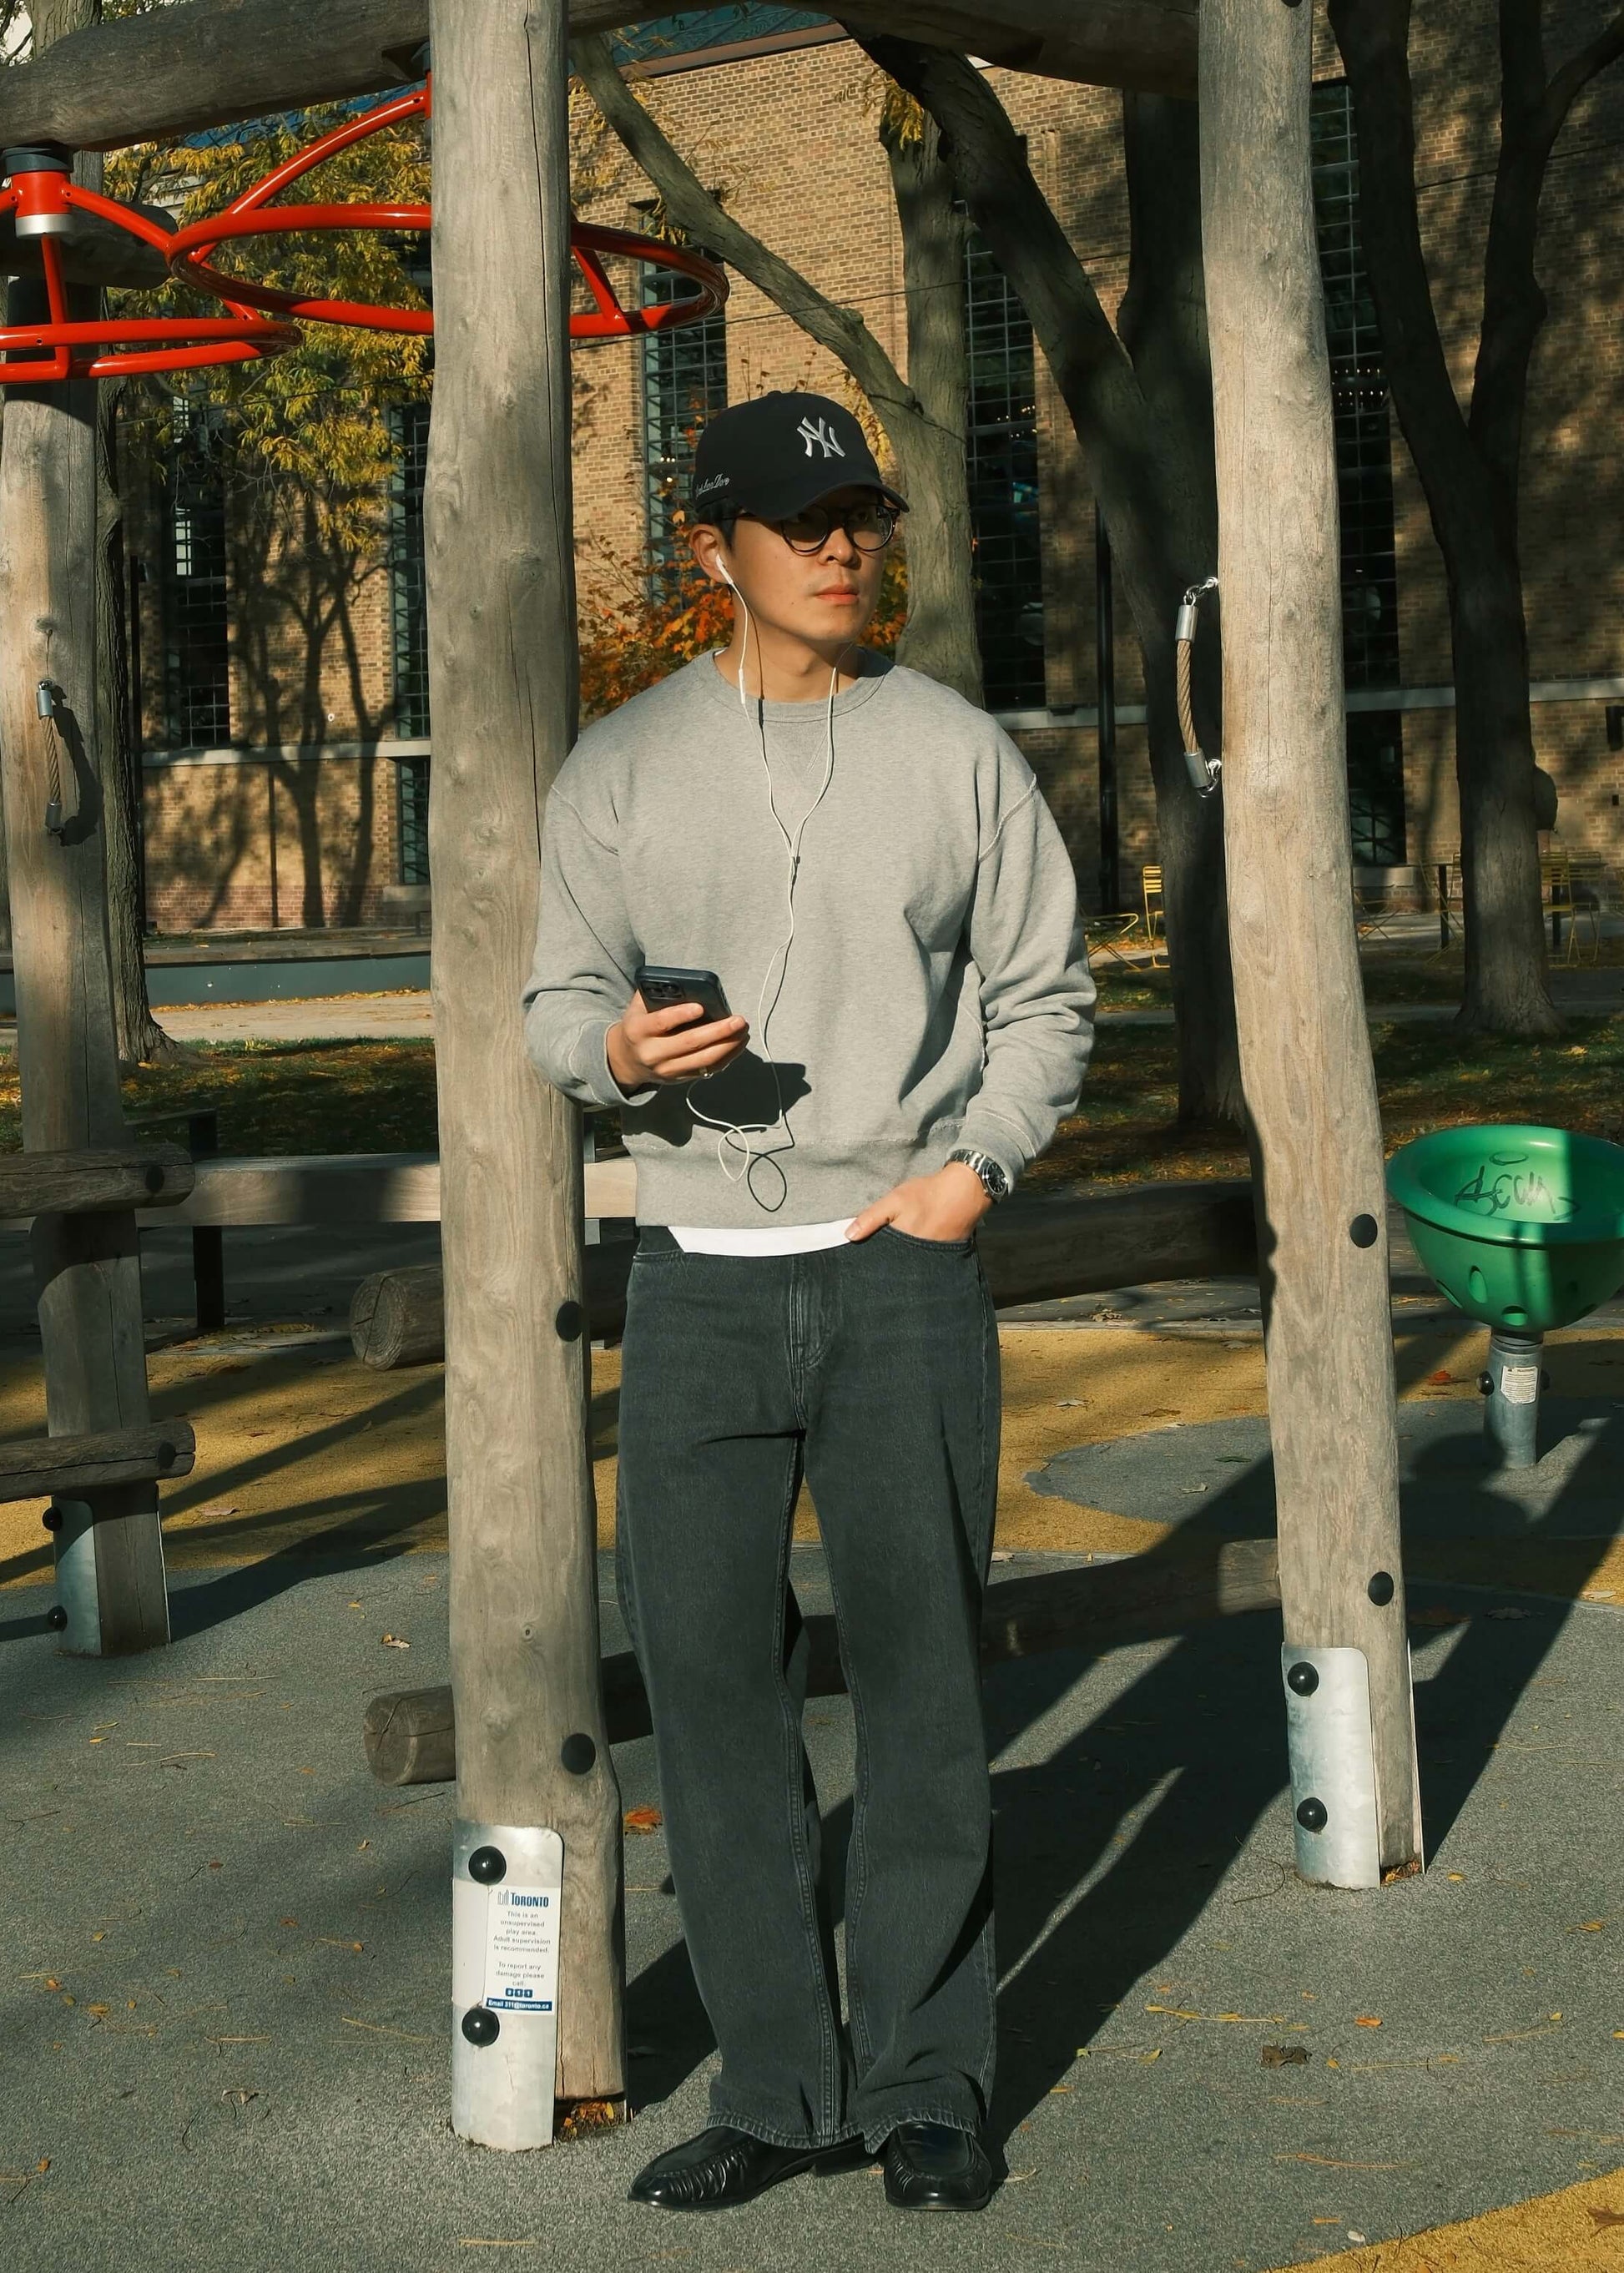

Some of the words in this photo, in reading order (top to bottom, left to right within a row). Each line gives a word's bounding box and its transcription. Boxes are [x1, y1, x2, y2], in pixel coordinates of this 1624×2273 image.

[796, 416, 846, 458] NY
[511, 1892, 549, 1908] TORONTO
[496, 1970, 522, 1978] damage
